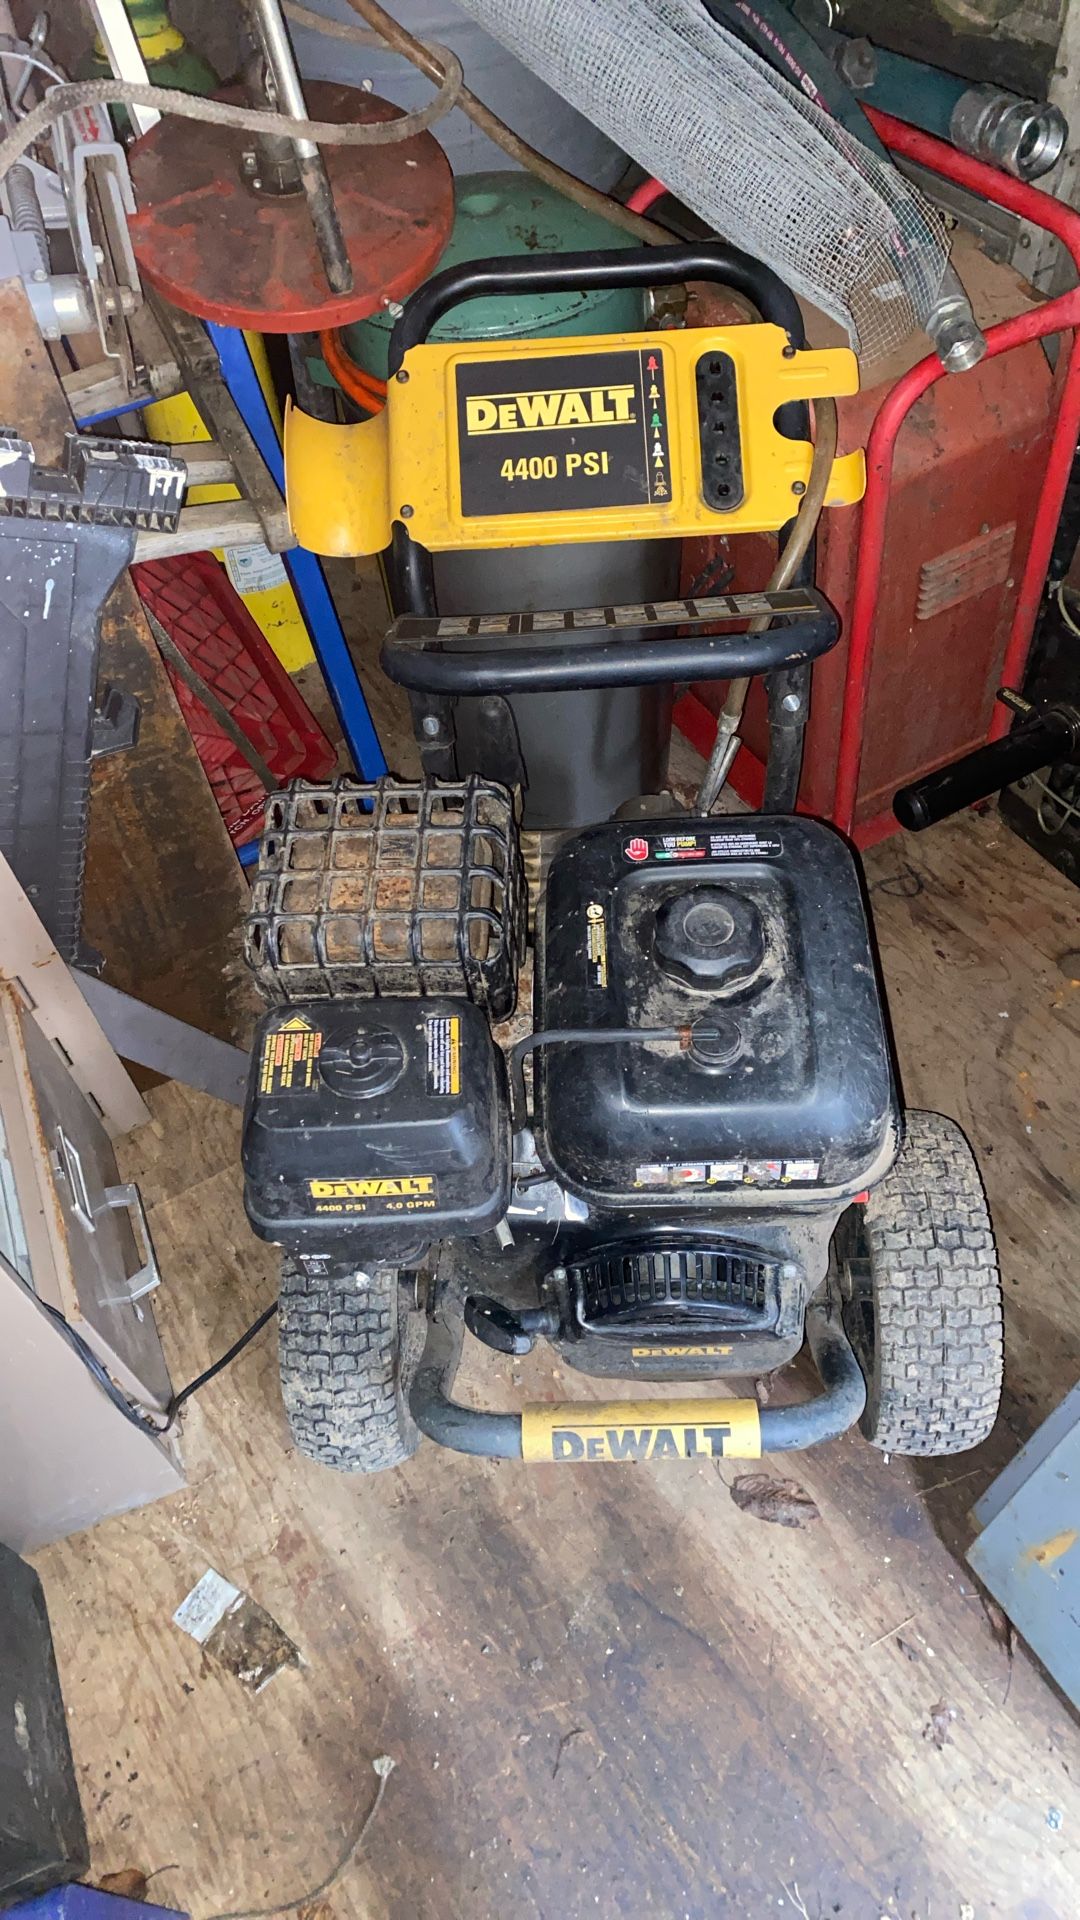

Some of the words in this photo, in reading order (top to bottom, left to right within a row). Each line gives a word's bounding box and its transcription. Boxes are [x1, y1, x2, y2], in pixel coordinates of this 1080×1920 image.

[500, 456, 557, 481] 4400
[566, 451, 609, 477] PSI
[315, 1203, 343, 1212] 4400
[345, 1204, 366, 1212] PSI
[386, 1202, 403, 1210] 4.0
[406, 1200, 435, 1209] GPM
